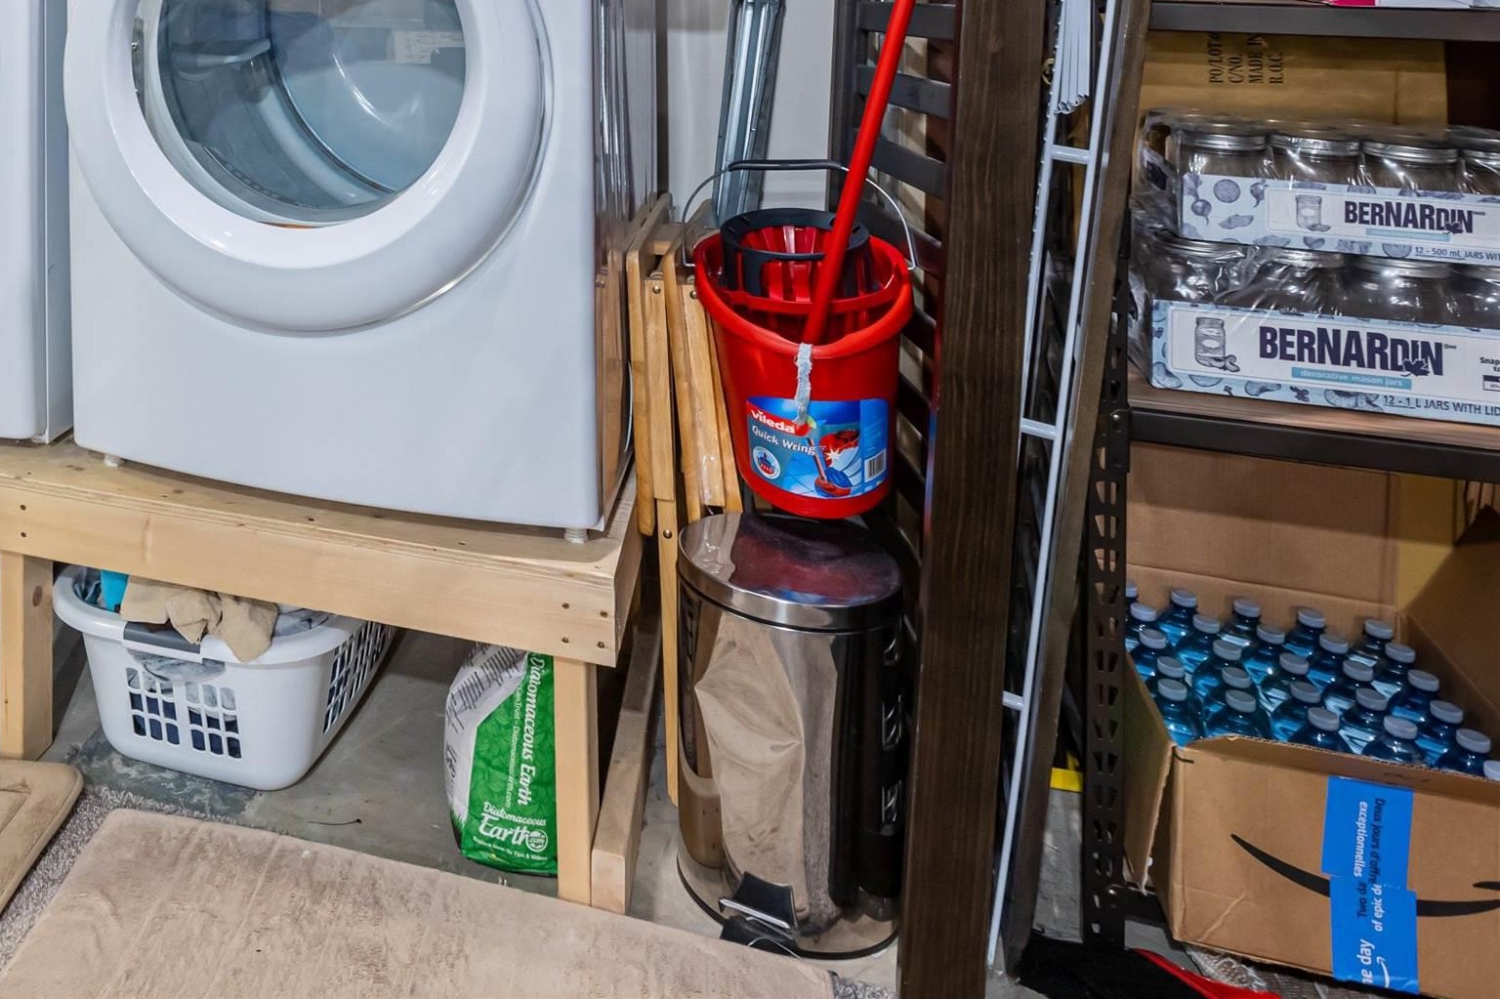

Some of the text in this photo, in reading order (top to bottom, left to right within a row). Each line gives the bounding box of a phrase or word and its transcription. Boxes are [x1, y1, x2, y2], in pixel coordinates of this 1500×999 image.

[1228, 54, 1244, 83] C/NO.
[1247, 33, 1264, 84] MADE IN
[1268, 52, 1284, 84] R.O.C.
[1344, 201, 1473, 234] BERNARDIN
[1415, 246, 1423, 254] 12
[1432, 247, 1447, 256] 500
[1449, 249, 1461, 258] mL
[1464, 250, 1484, 260] JARS
[1259, 325, 1444, 377] BERNARDIN
[1300, 369, 1403, 388] decorative mason jars
[1383, 395, 1395, 405] 12
[1424, 399, 1449, 411] JARS
[1452, 402, 1481, 413] WITH
[750, 409, 795, 434] vileda
[751, 425, 817, 456] Quick Wring
[513, 702, 522, 719] Trust
[517, 656, 545, 806] Diatomaceous Earth
[483, 801, 547, 826] Diatomaceous
[1374, 798, 1386, 821] Deux
[478, 812, 528, 846] Earth
[1353, 801, 1368, 877] exceptionnelles
[1370, 823, 1384, 849] jours
[1357, 898, 1368, 918] Two
[1371, 898, 1385, 919] epic
[1371, 919, 1383, 931] of
[1356, 938, 1375, 965] day
